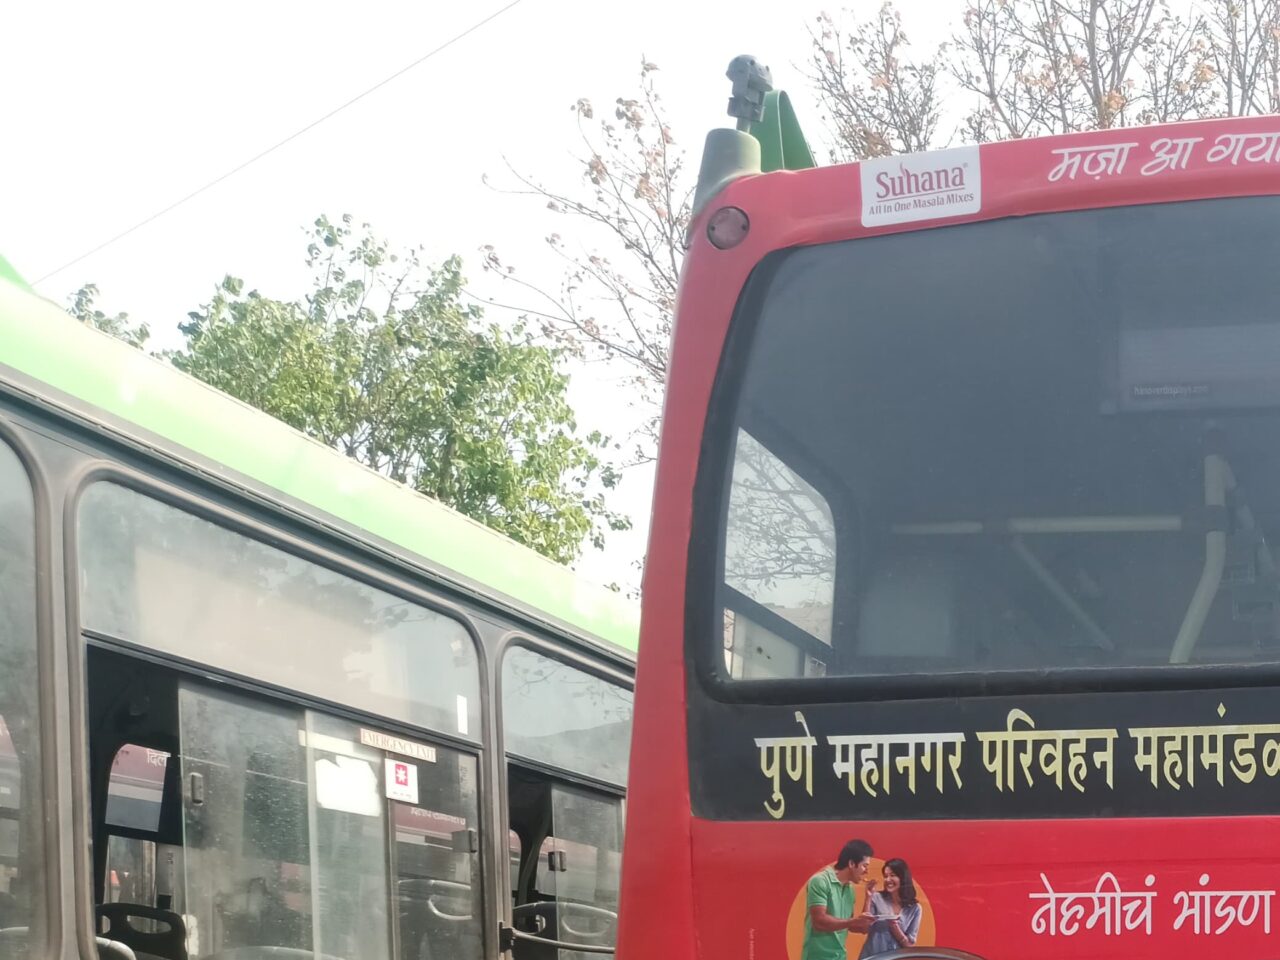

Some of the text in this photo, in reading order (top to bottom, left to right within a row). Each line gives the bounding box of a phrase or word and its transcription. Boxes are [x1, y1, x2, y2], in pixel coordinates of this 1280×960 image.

[1140, 136, 1203, 176] आ
[868, 191, 974, 216] All in One Masala Mixes
[754, 711, 818, 819] पुणे
[826, 731, 966, 798] महानगर
[976, 708, 1119, 793] परिवहन
[1029, 871, 1158, 936] नेहमीचं
[1173, 873, 1275, 935] भांडण
